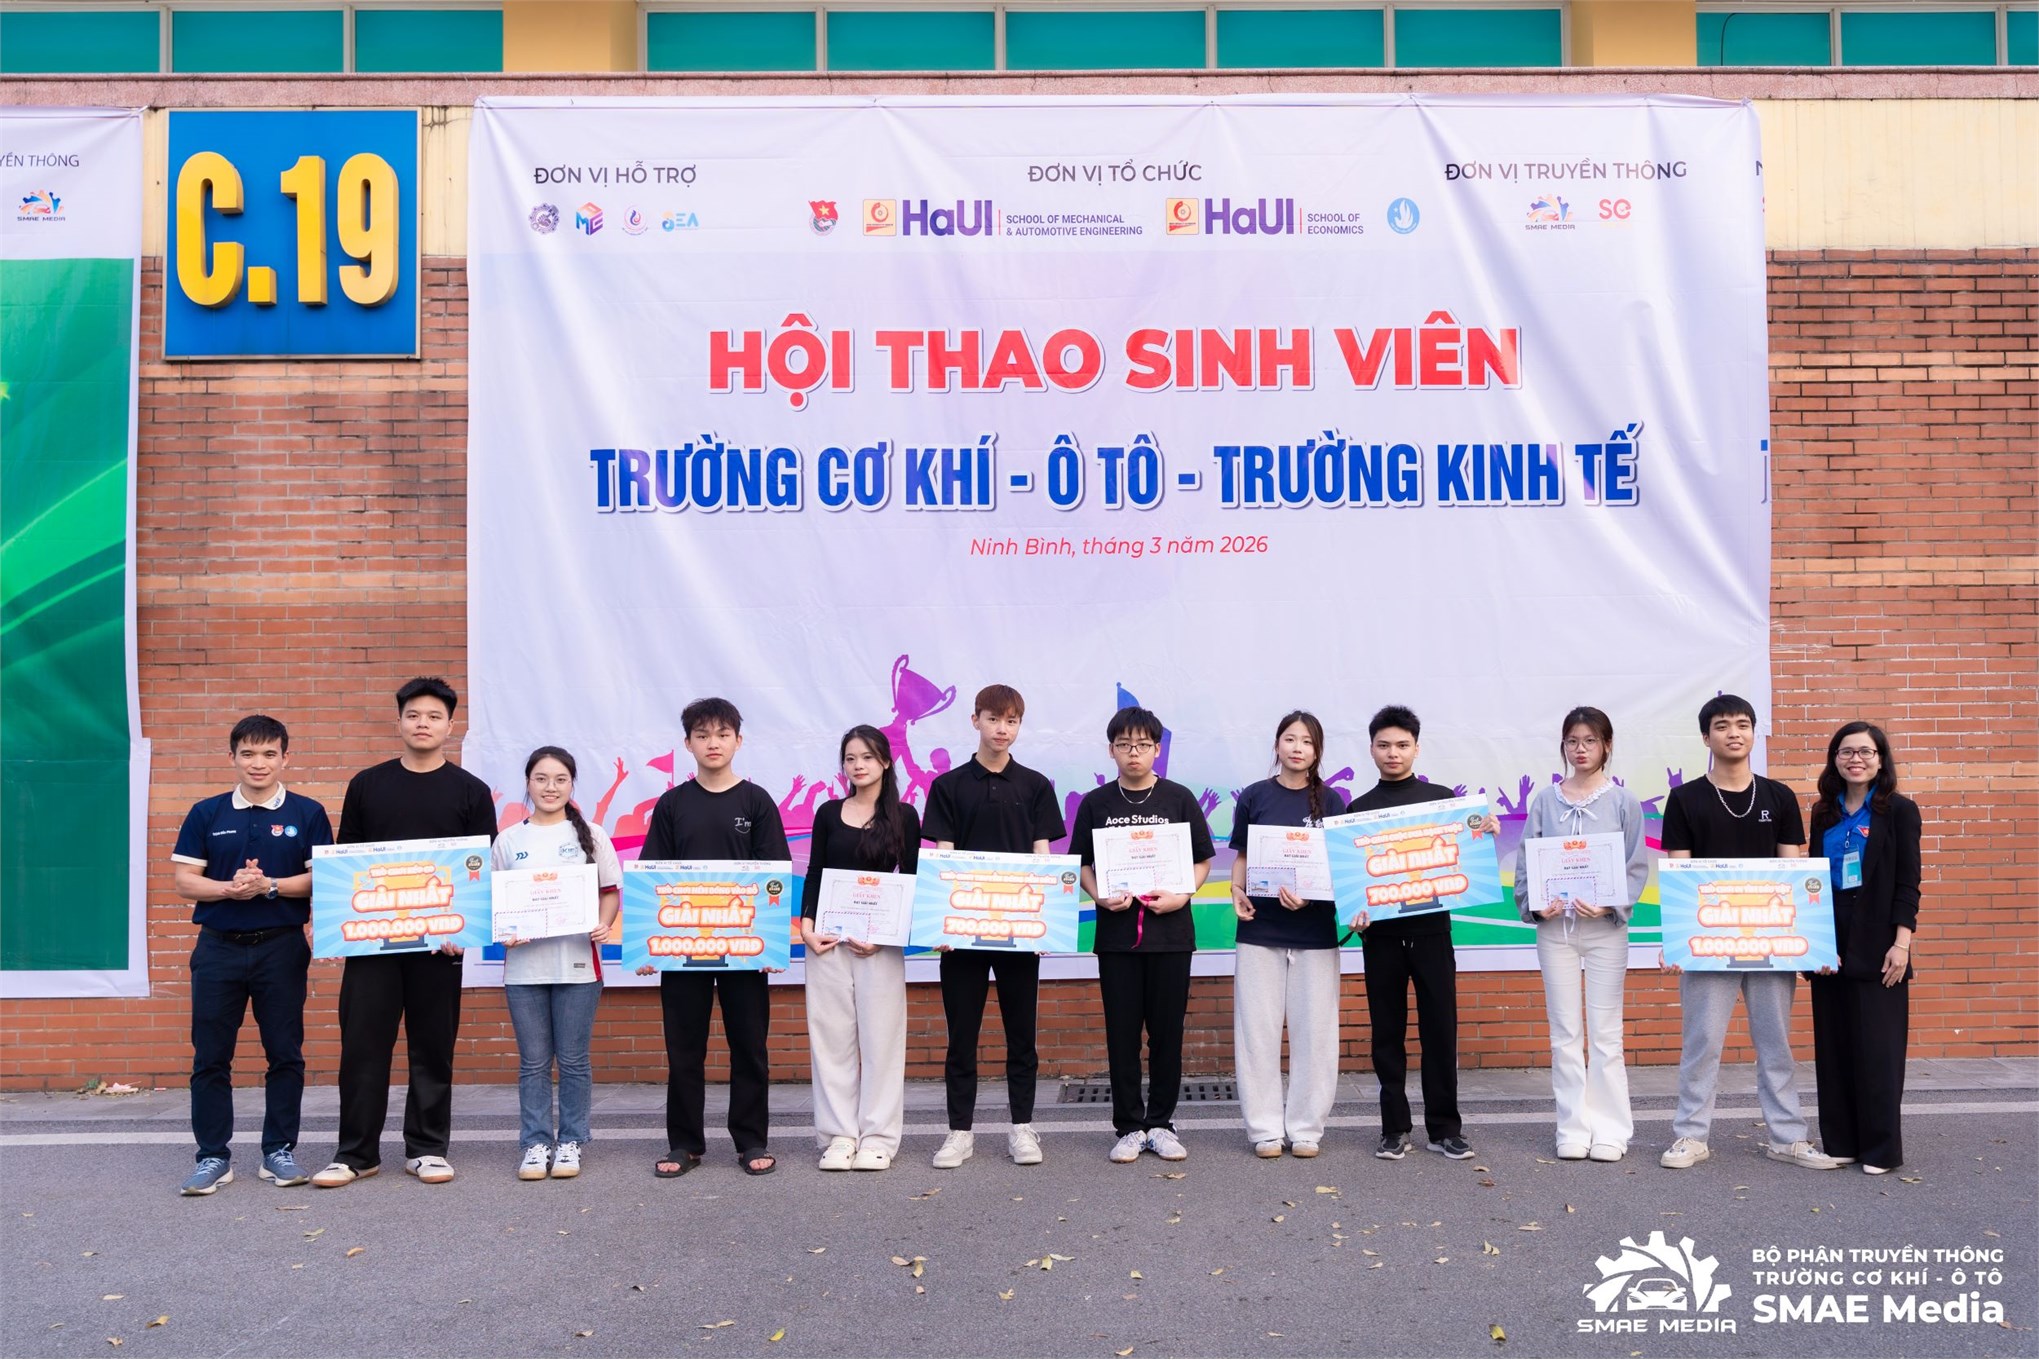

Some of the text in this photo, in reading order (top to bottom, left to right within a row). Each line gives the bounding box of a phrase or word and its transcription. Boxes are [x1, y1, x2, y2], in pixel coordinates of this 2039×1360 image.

[28, 152, 80, 167] THÔNG
[1444, 157, 1688, 184] ĐƠN VỊ TRUYỀN THÔNG
[533, 160, 697, 188] ĐƠN VỊ HỖ TRỢ
[1027, 158, 1203, 186] ĐƠN VỊ TỔ CHỨC
[902, 199, 993, 236] HaUI
[1006, 214, 1125, 224] SCHOOL OF MECHANICAL
[1204, 198, 1295, 235] HaUI
[1307, 213, 1361, 223] SCHOOL OF
[176, 151, 400, 308] C.19
[1006, 226, 1143, 236] & AUTOMOTIVE ENGINEERING
[1307, 225, 1364, 235] ECONOMICS
[708, 310, 1520, 409] HỘI THAO SINH VIÊN
[590, 433, 800, 508] TRƯỜNG
[817, 440, 889, 508] CƠ
[904, 434, 995, 506] KHÍ
[1047, 434, 1081, 508] Ô
[1097, 433, 1161, 506] TÔ
[1213, 429, 1419, 505] TRƯỜNG
[1437, 443, 1561, 504] KINH
[1574, 422, 1640, 503] TẾ
[970, 535, 1269, 559] Ninh Bình, tháng 3 năm 2026
[1105, 814, 1170, 826] Aoce Studios
[1370, 882, 1433, 903] 700.000
[660, 897, 752, 923] GIẢI NHẤT
[345, 920, 426, 938] 1.000.000
[651, 939, 728, 953] 1.000.000
